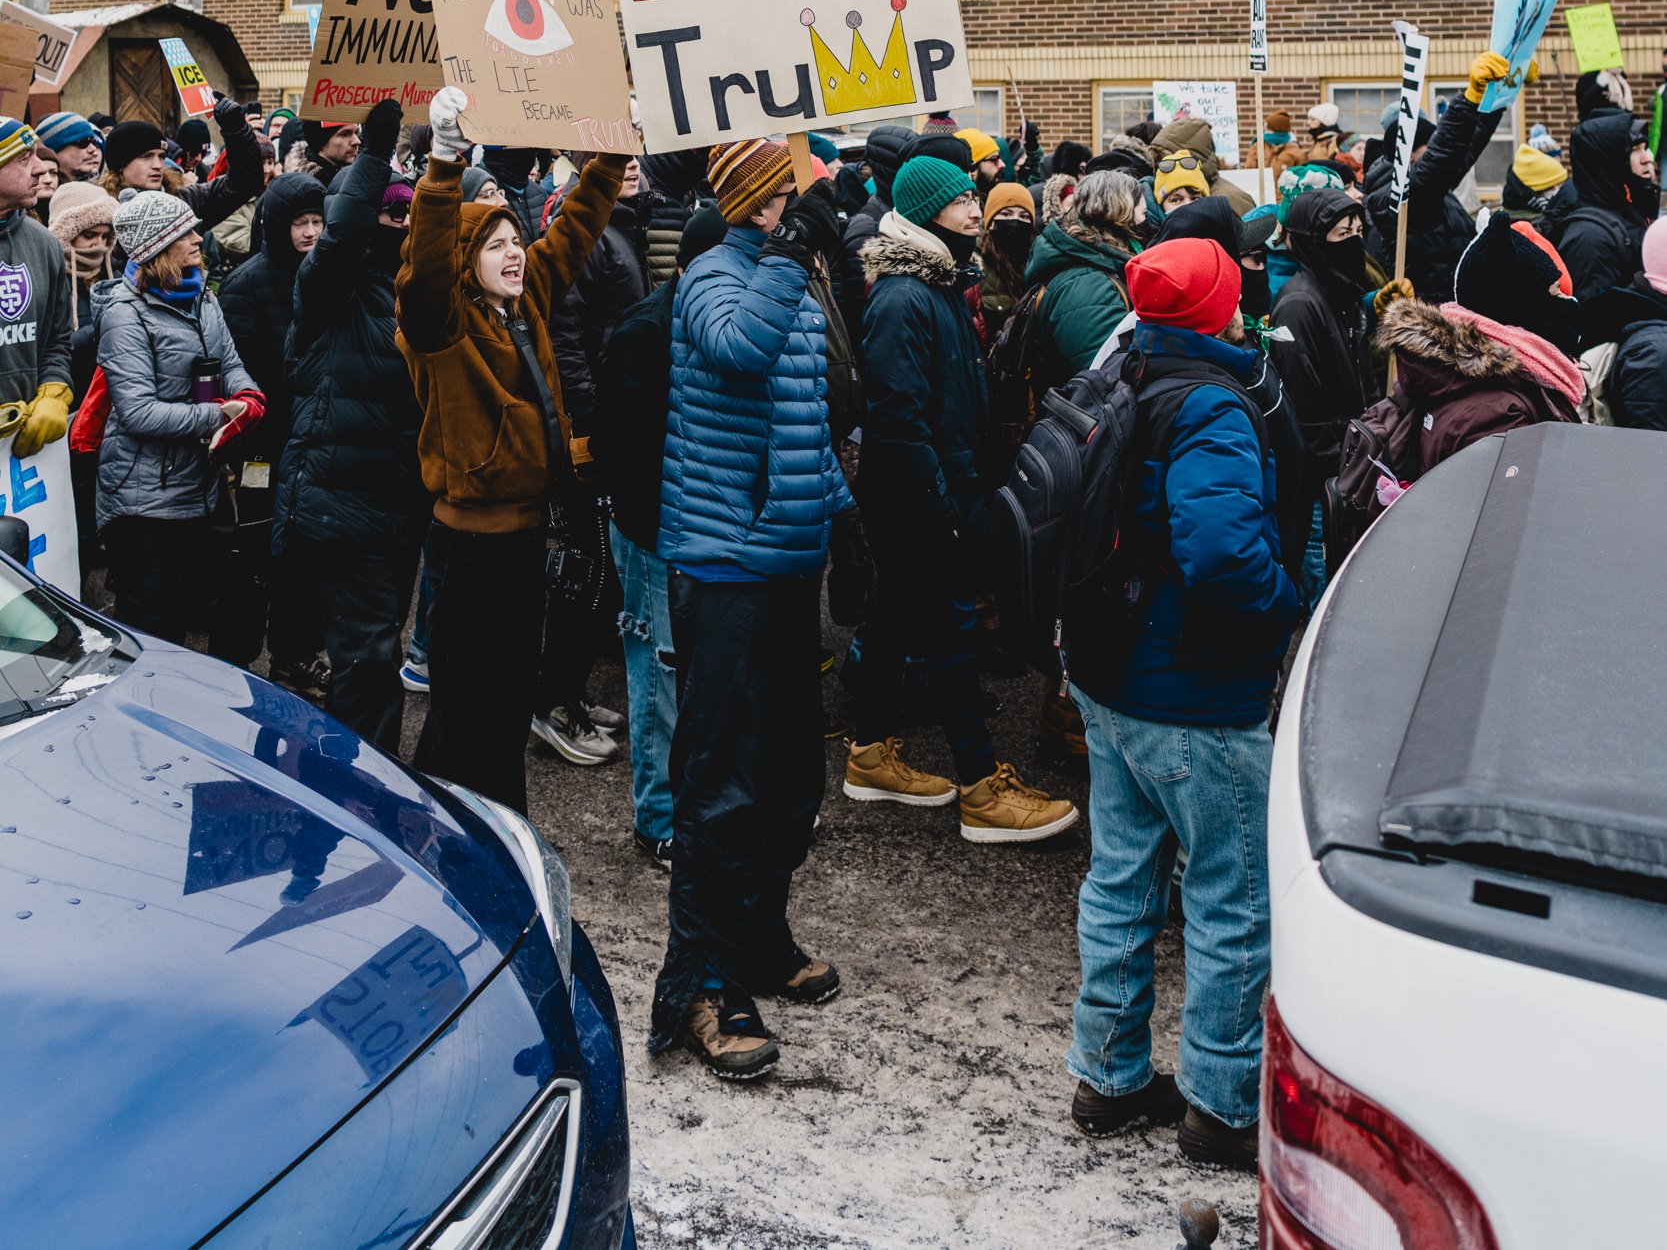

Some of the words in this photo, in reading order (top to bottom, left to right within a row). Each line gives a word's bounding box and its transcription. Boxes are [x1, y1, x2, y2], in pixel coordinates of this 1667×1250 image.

[177, 65, 204, 86] ICE
[444, 55, 477, 84] THE
[493, 60, 540, 93] LIE
[312, 77, 397, 108] PROSECUTE
[1178, 82, 1196, 94] We
[1199, 82, 1230, 94] take
[1197, 97, 1218, 105] our
[1203, 105, 1223, 116] ICE
[521, 99, 574, 121] BECAME
[570, 116, 637, 151] TRUTH
